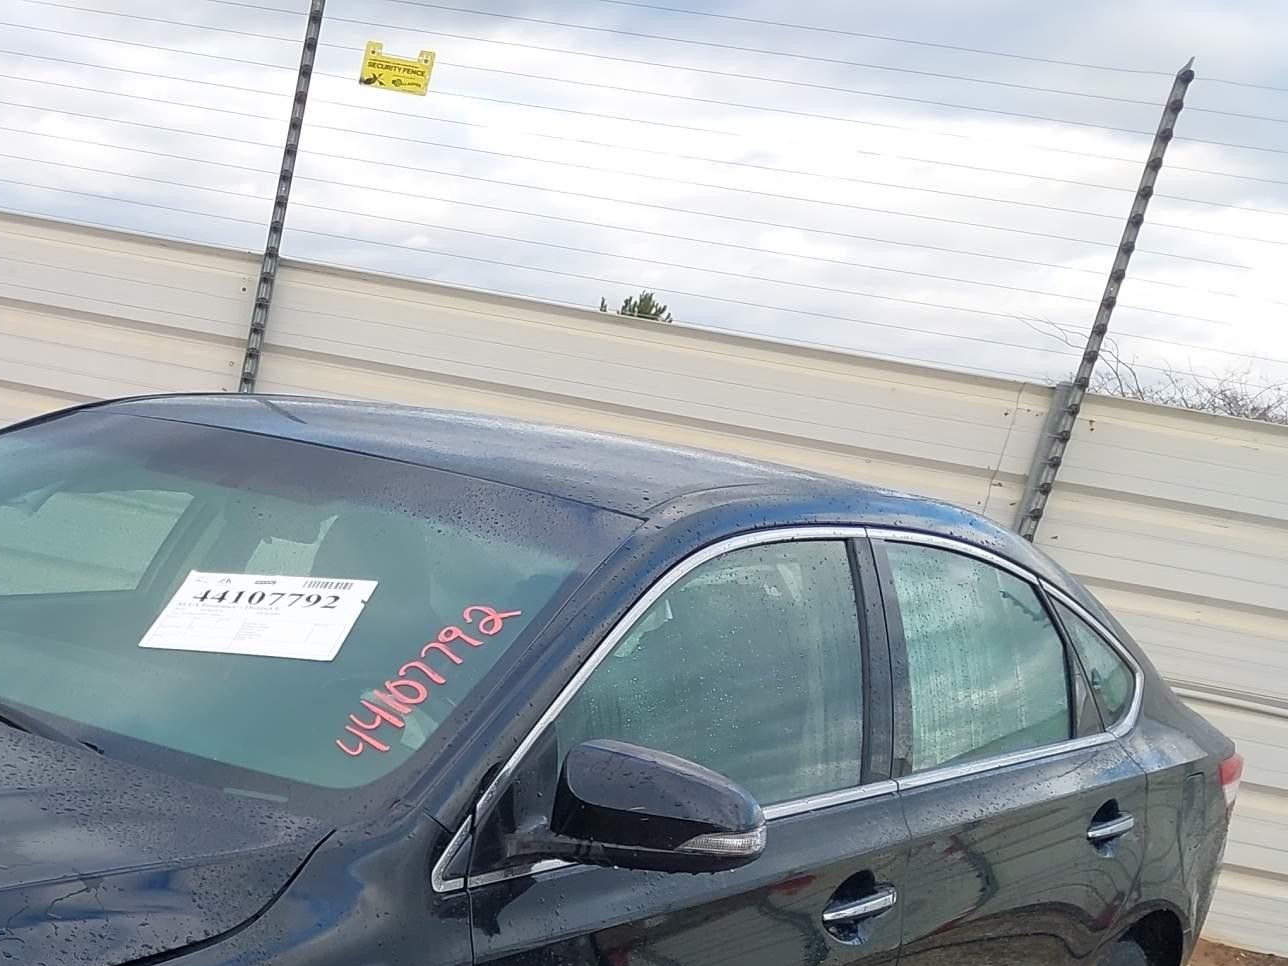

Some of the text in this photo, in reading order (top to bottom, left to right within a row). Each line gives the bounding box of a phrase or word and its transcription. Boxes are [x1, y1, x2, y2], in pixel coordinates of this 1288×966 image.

[367, 61, 403, 73] SECURITY
[402, 67, 426, 77] FENCE
[192, 588, 341, 609] 44107792
[335, 605, 522, 757] 44107792
